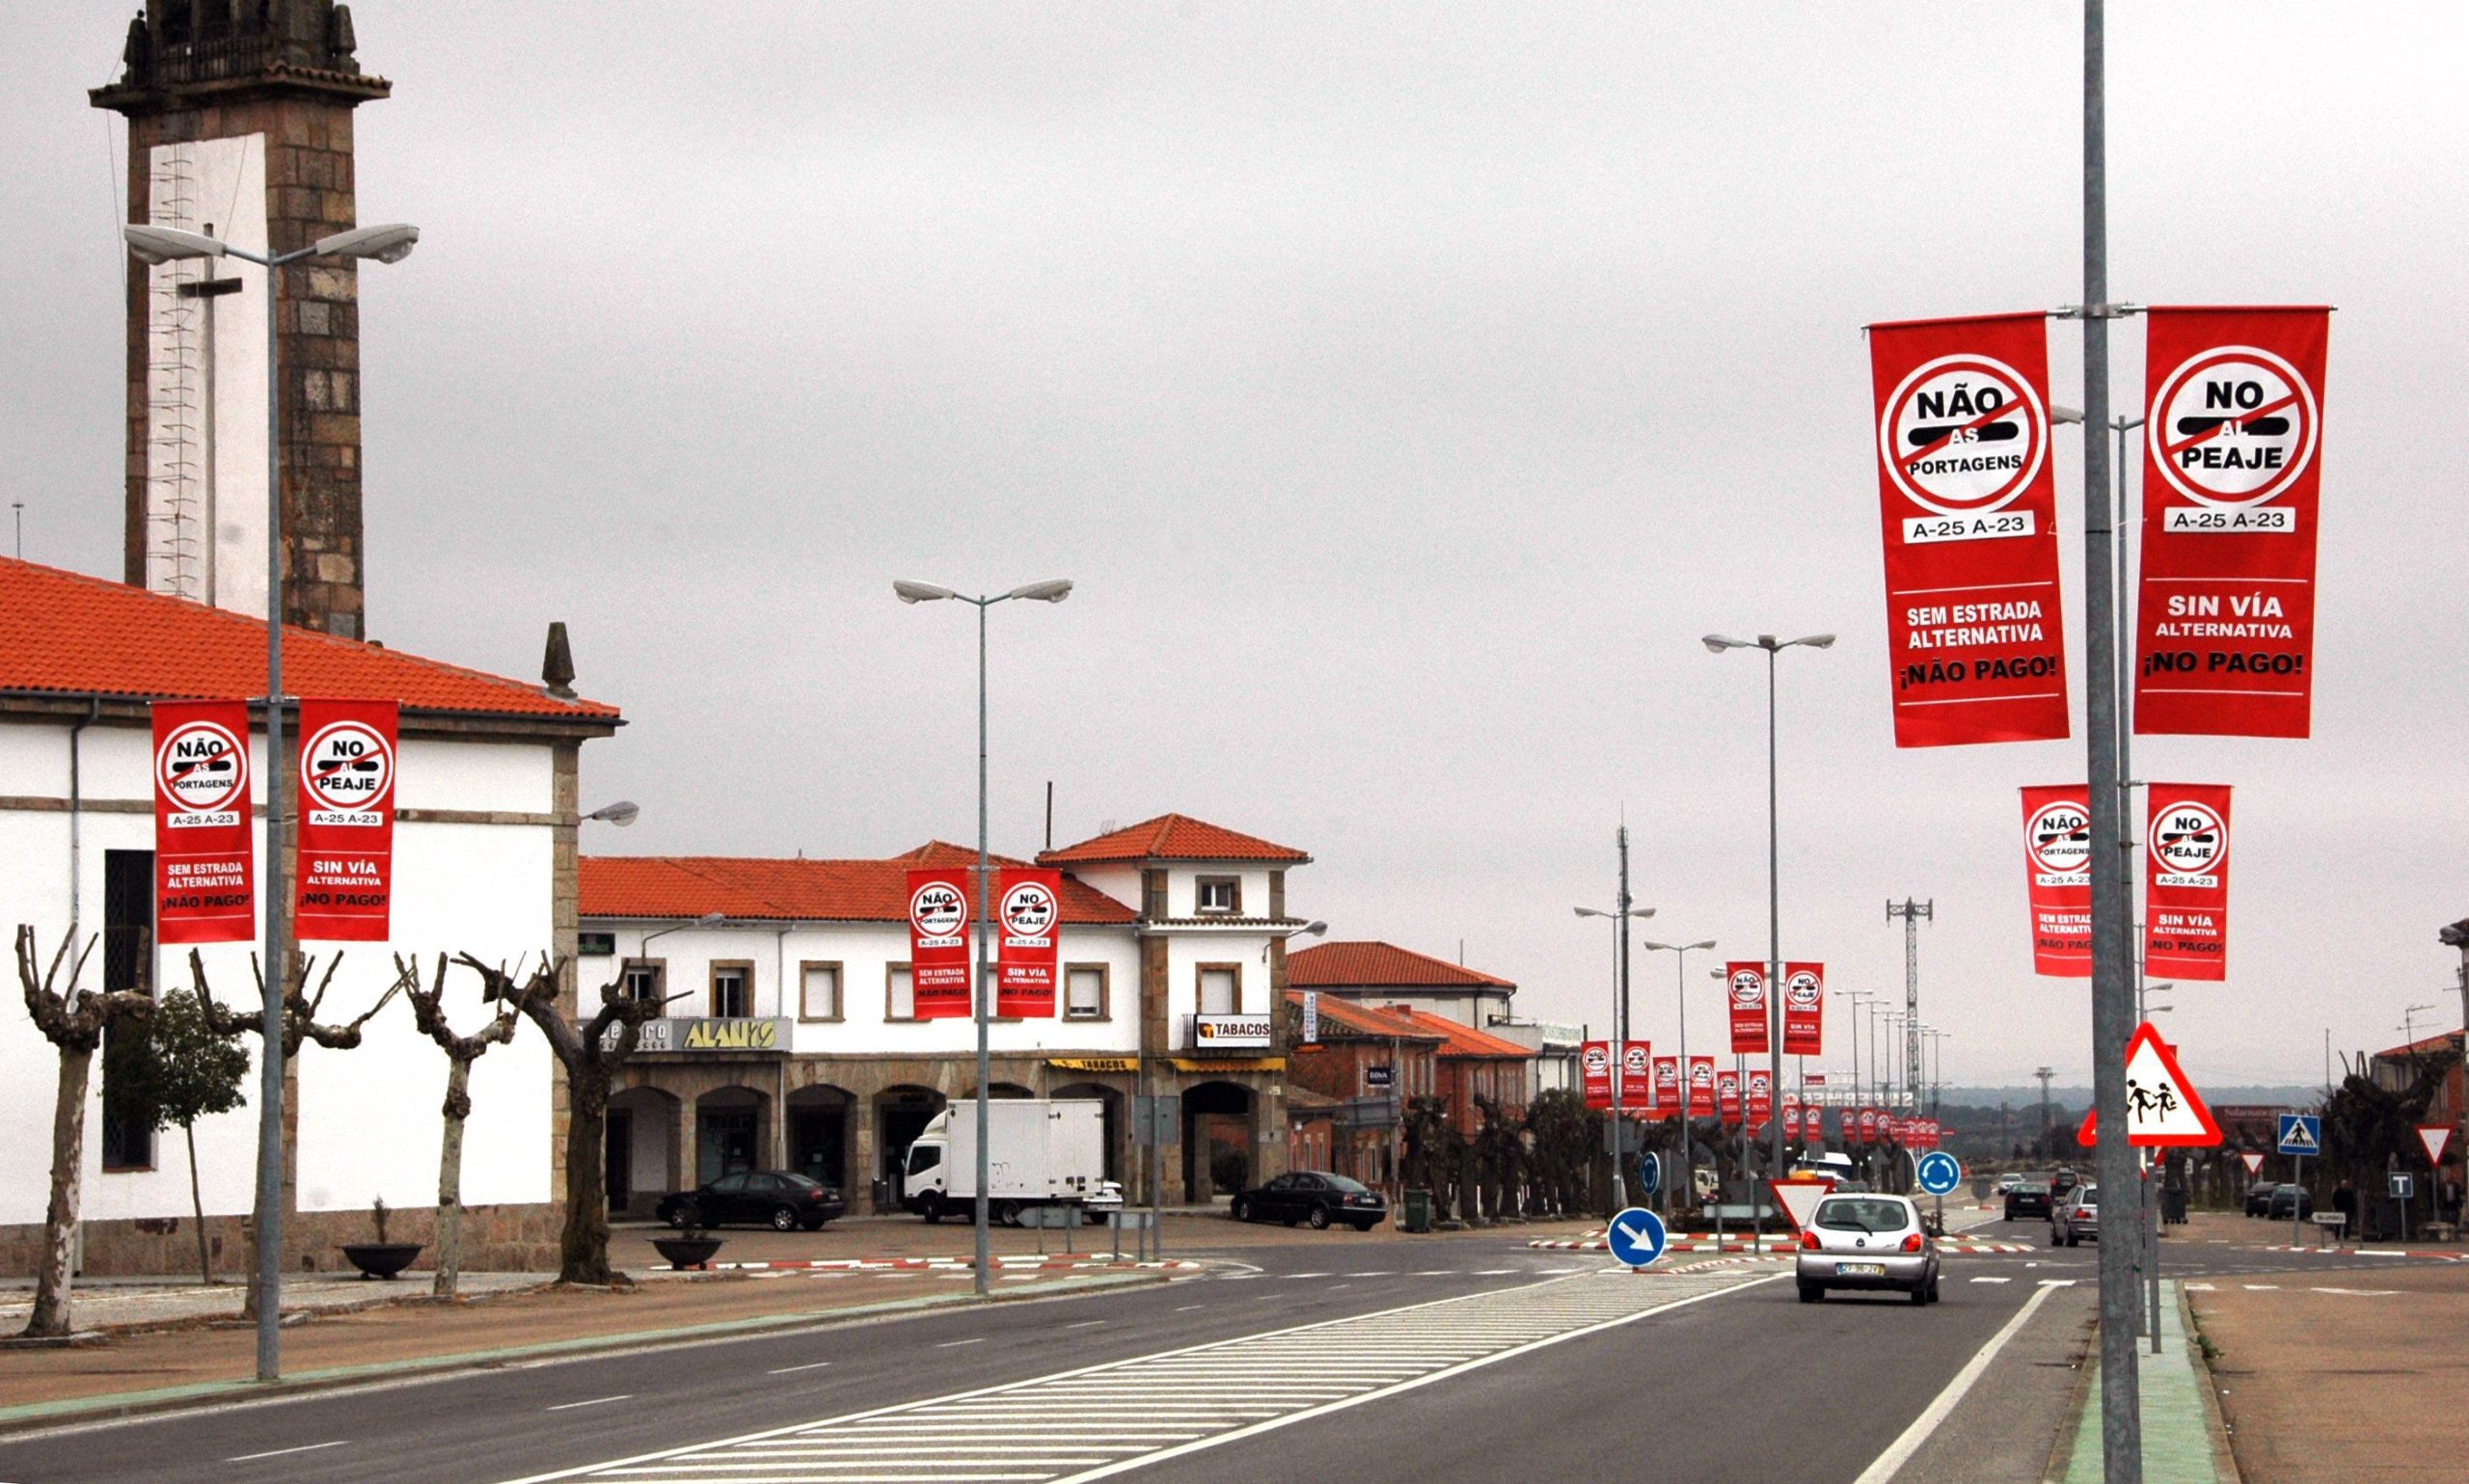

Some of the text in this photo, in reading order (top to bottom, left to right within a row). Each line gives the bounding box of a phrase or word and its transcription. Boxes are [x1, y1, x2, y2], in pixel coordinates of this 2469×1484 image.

[1916, 383, 2004, 418] NÃO
[2205, 381, 2265, 410] NO
[2217, 419, 2249, 437] AL
[1948, 427, 1980, 445] AS
[2181, 446, 2284, 470] PEAJE
[1909, 455, 2023, 476] PORTAGENS
[1913, 517, 2025, 538] A-25 A-23
[2173, 513, 2286, 528] A-25 A-23
[2167, 592, 2284, 618] SIN VÍA
[1907, 601, 2043, 627] SEM ESTRADA
[1909, 623, 2044, 649] ALTERNATIVA
[2156, 622, 2293, 639] ALTERNATIVA
[2144, 652, 2303, 676] ¡NO PAGO!
[1900, 656, 2057, 689] ¡NÃO PAGO!
[176, 738, 224, 758] NÃO
[333, 741, 365, 756] NO
[173, 779, 234, 790] PORTAGENS
[319, 777, 375, 790] PEAJE
[173, 814, 234, 825] A-25 A-23
[314, 814, 378, 823] A-25 A-23
[2042, 814, 2082, 830] NÃO
[2176, 817, 2202, 830] NO
[2164, 847, 2211, 858] PEAJE
[168, 862, 243, 876] SEM ESTRADA
[313, 859, 377, 875] SIN VÍA
[168, 875, 244, 889] ALTERNATIVA
[307, 876, 381, 886] ALTERNATIVA
[2040, 876, 2064, 884] A-25
[2160, 876, 2213, 886] A-25 A-23
[204, 894, 250, 907] PAGO!
[336, 894, 386, 906] PAGO!
[1019, 894, 1039, 904] NO
[1012, 916, 1046, 925] PEAJE
[2038, 913, 2091, 924] SEM ESTRAD
[2158, 913, 2212, 927] SIN VÍA
[2039, 923, 2091, 934] ALTERNATI
[2153, 926, 2217, 936] ALTERNATIVA
[2068, 939, 2092, 950] PAG
[1007, 967, 1025, 977] SIN
[1216, 1023, 1270, 1036] TABACOS
[1081, 1060, 1127, 1069] TABACOS
